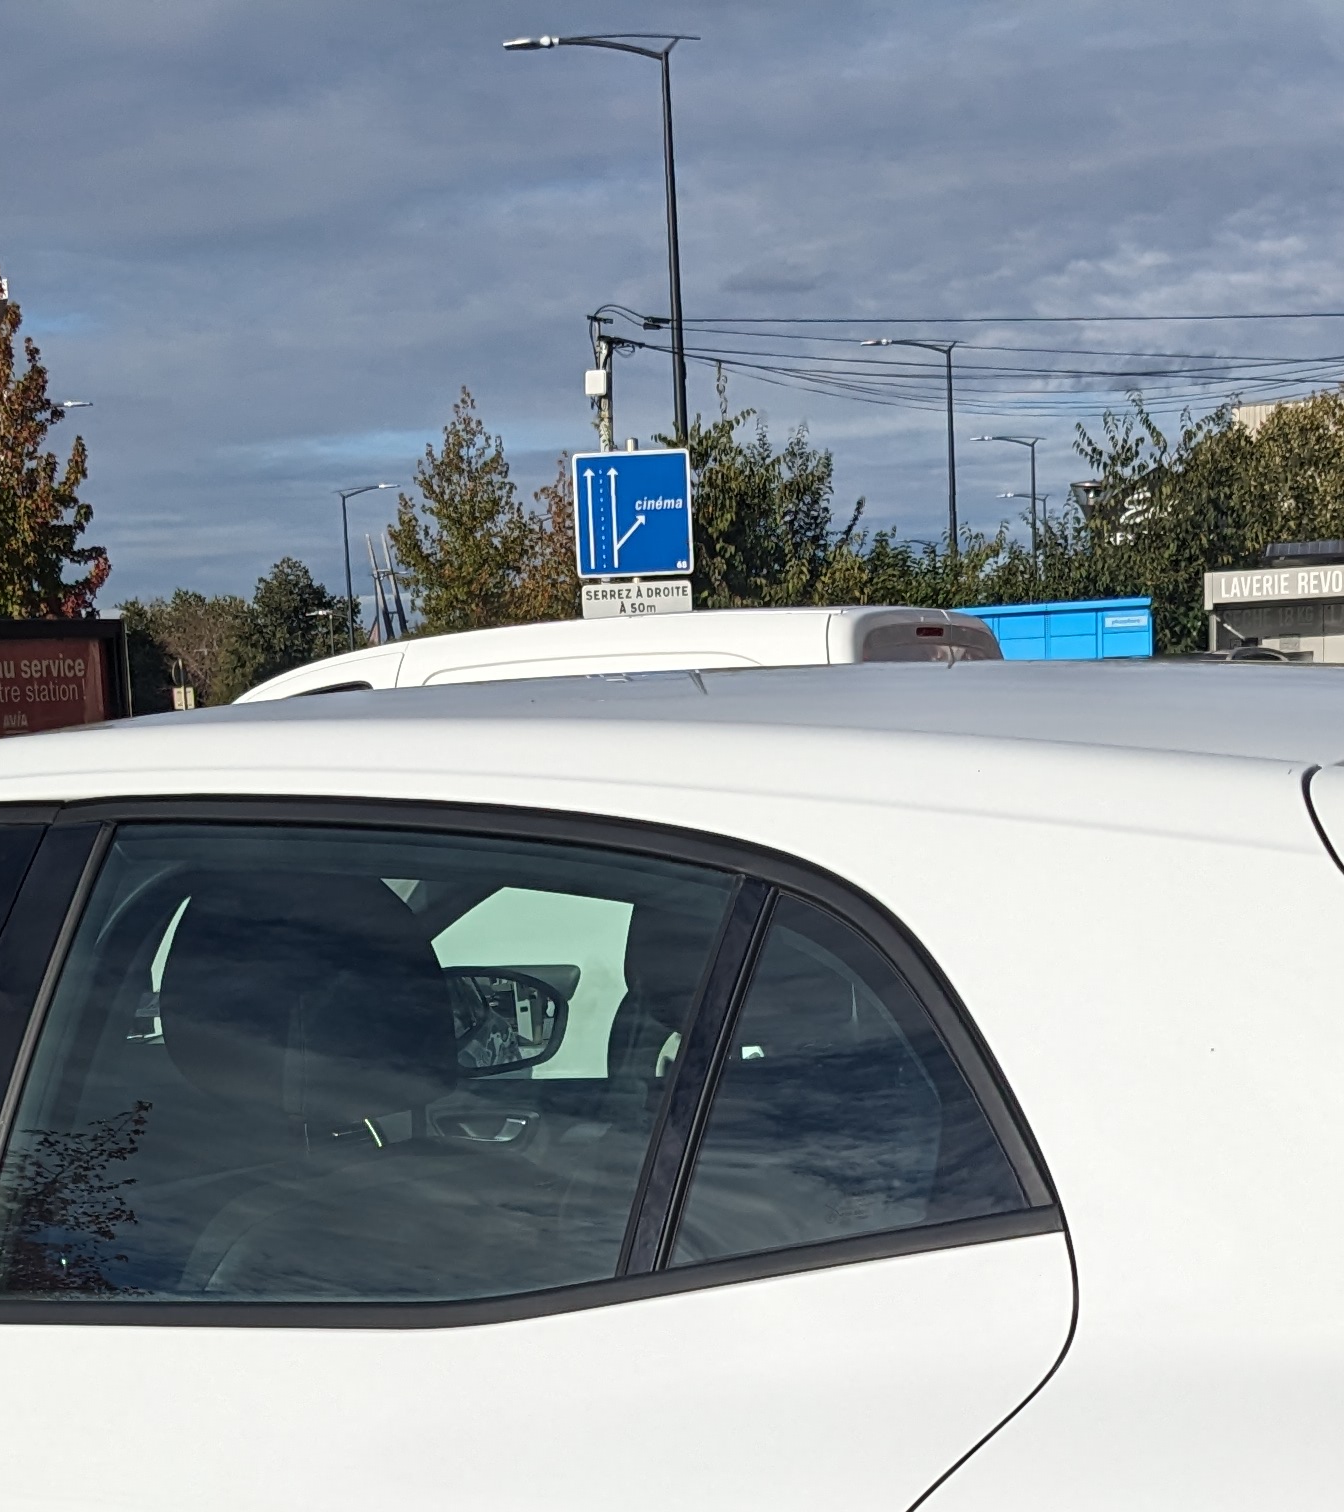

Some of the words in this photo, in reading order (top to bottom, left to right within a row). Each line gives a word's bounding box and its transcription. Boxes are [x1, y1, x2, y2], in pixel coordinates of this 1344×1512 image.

[635, 495, 684, 511] cinéma
[585, 588, 633, 601] SERREZ
[635, 585, 644, 599] À
[646, 585, 689, 599] DROITE
[1220, 572, 1290, 599] LAVERIE
[619, 601, 627, 615] À
[630, 602, 657, 614] 50m
[20, 653, 86, 679] service
[25, 680, 79, 703] station
